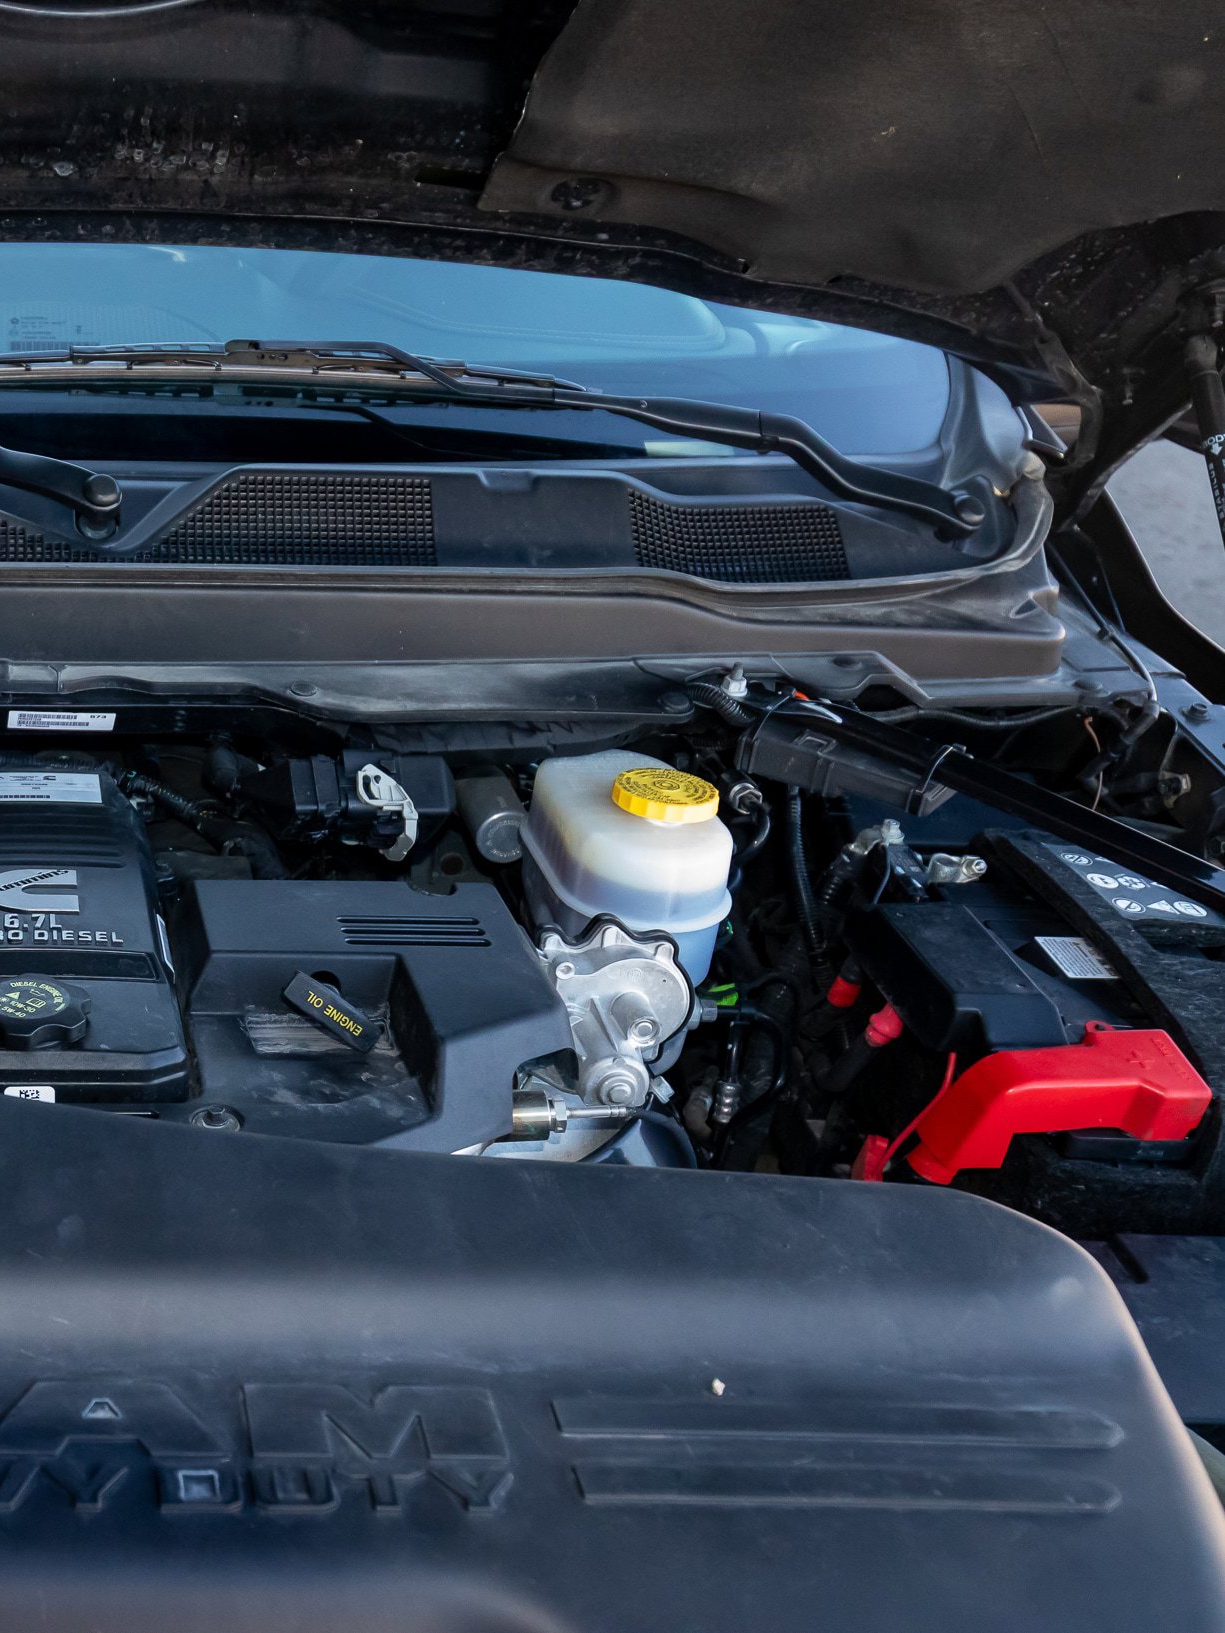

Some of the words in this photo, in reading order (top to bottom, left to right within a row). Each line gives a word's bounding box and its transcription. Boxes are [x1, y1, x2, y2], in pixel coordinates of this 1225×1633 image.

[4, 914, 63, 930] 6.7L
[33, 930, 124, 944] DIESEL
[39, 983, 62, 997] ENGINE
[307, 991, 323, 1007] OIL
[1, 1006, 26, 1017] 5W-40
[10, 1001, 36, 1013] 10W-30
[324, 1005, 363, 1036] ENGINE
[156, 1456, 515, 1515] DUTY
